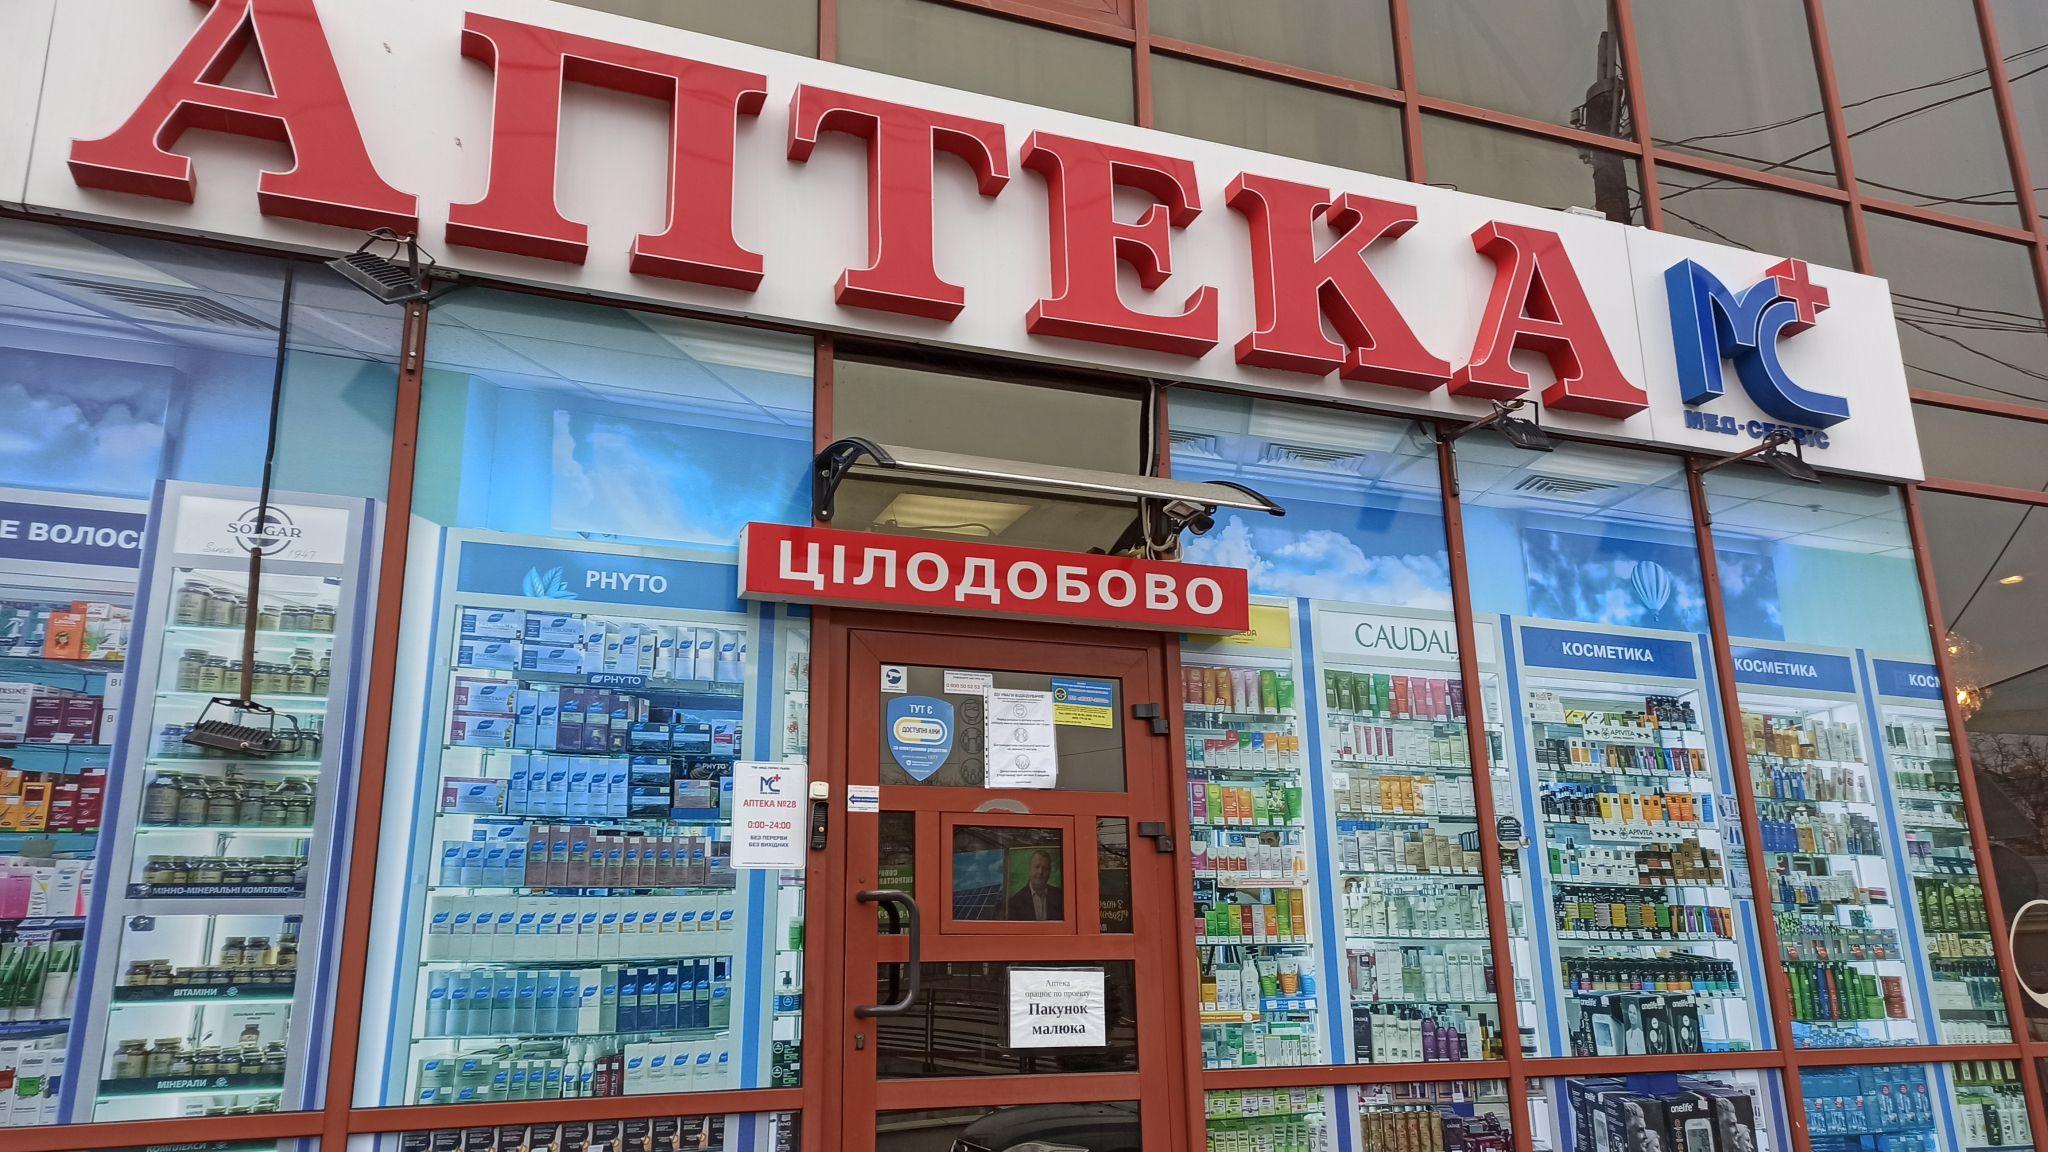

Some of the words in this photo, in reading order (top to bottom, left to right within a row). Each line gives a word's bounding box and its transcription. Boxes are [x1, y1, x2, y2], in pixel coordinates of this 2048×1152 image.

[68, 0, 1649, 420] АПТЕКА
[1684, 410, 1830, 449] МЕД-СЕВІС
[585, 570, 668, 594] PHYTO
[778, 539, 1225, 615] ЦІЛОДОБОВО
[1355, 623, 1458, 655] CAUDAL
[1562, 641, 1655, 663] КОСМЕТИКА
[1733, 657, 1818, 678] КОСМЕТИКА
[604, 674, 642, 686] PHYTO
[909, 703, 926, 714] ТУТ
[1610, 729, 1636, 737] APIVITA
[702, 761, 728, 770] PHYTO
[743, 799, 776, 808] АПТЕКА
[776, 800, 797, 809] №28
[1045, 979, 1071, 988] Аптека
[173, 988, 218, 997] ВІТАМІНИ
[1028, 1002, 1089, 1019] Пакунок
[1032, 1024, 1086, 1036] малюка
[156, 1078, 208, 1089] МІНЕРАЛИ
[1670, 1102, 1694, 1114] onelife
